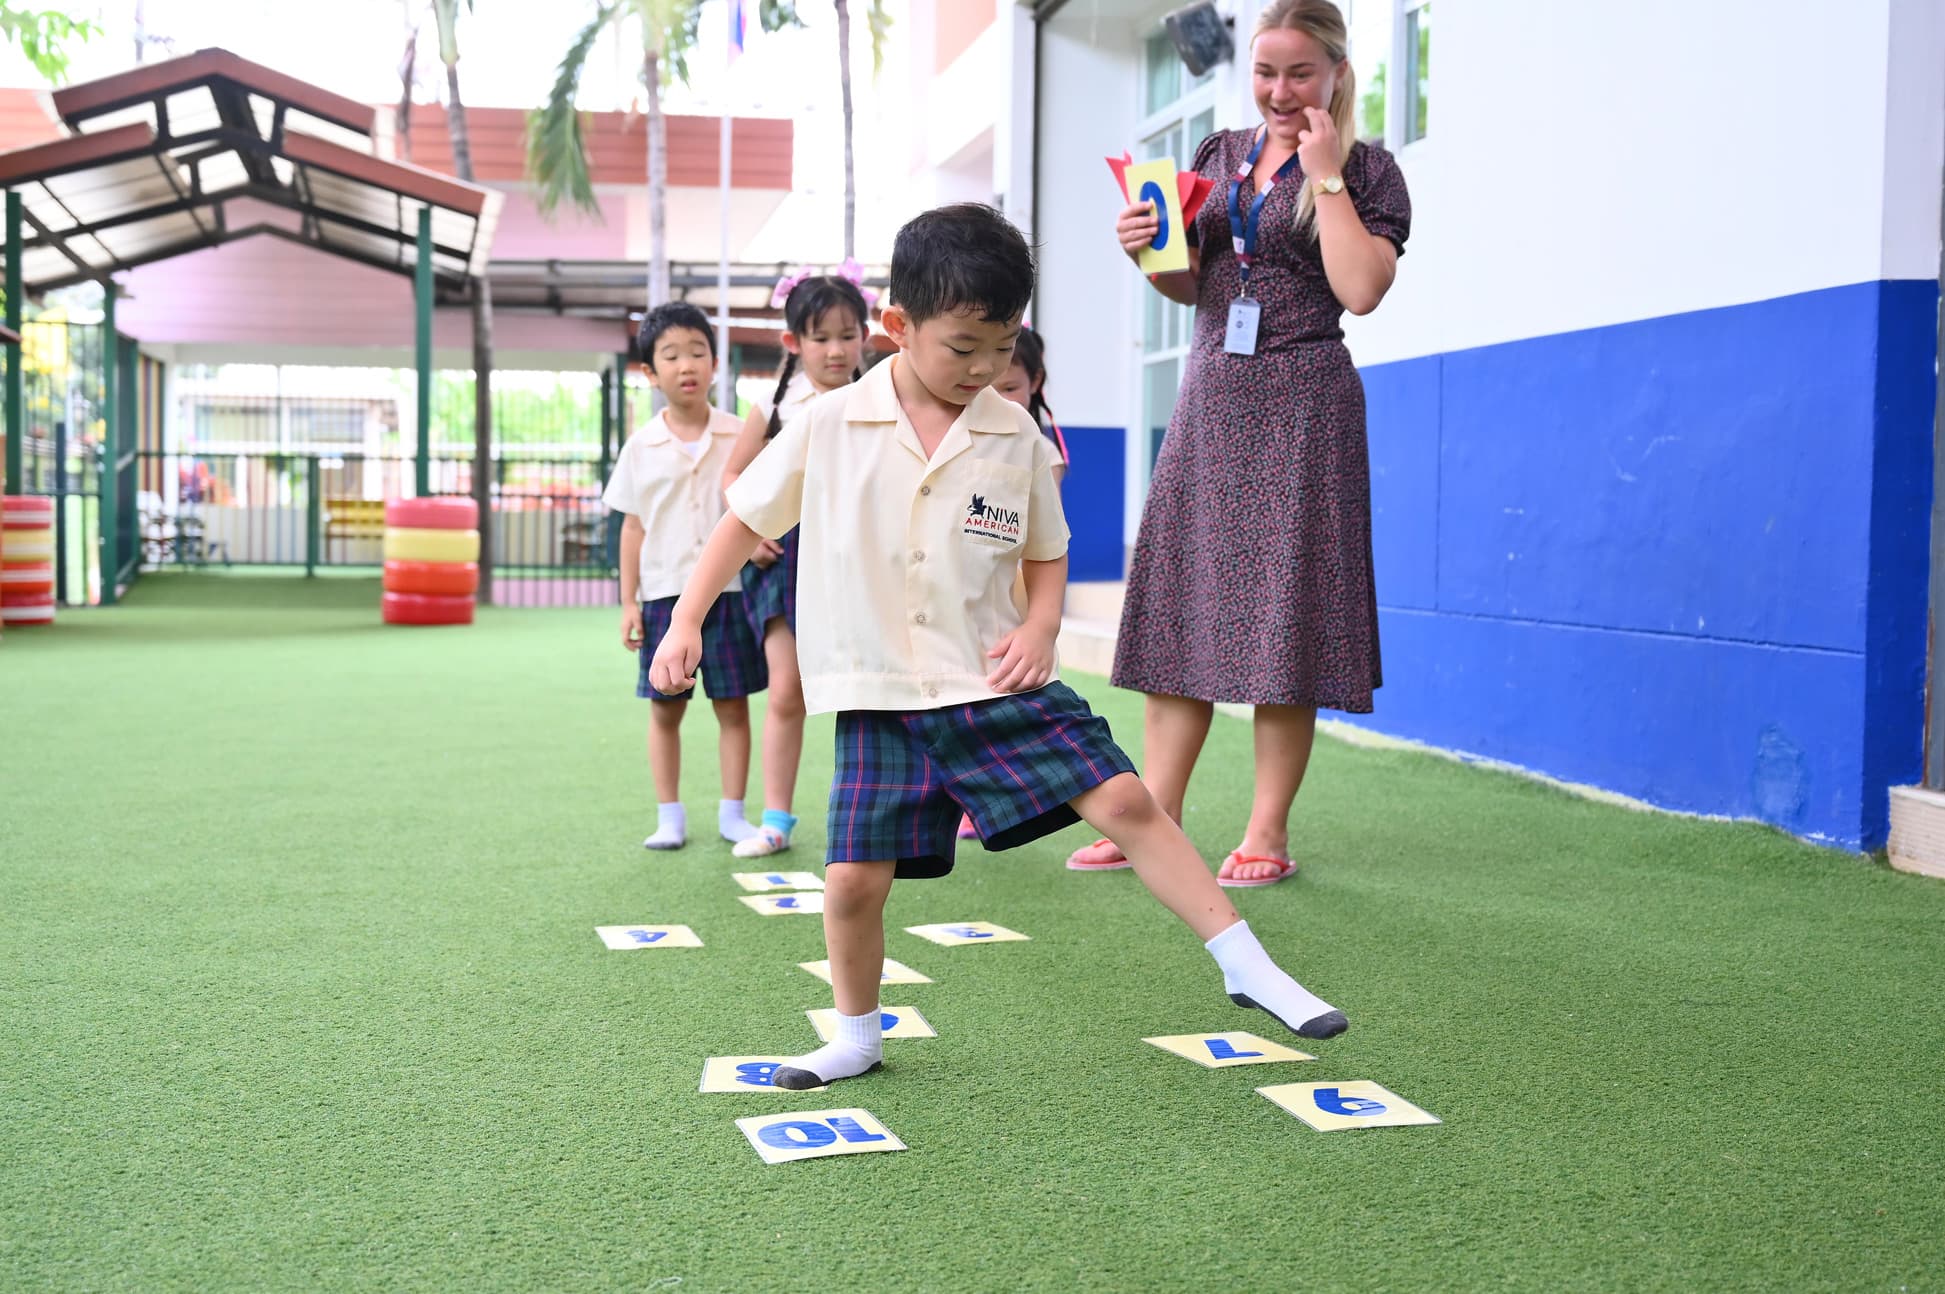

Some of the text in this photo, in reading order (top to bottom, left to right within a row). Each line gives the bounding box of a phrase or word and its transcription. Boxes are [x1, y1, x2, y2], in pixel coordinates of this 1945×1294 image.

[987, 506, 1020, 527] NIVA
[964, 528, 1018, 544] INTERNATIONAL SCHOOL
[965, 518, 1019, 535] AMERICAN
[757, 1117, 887, 1150] 10
